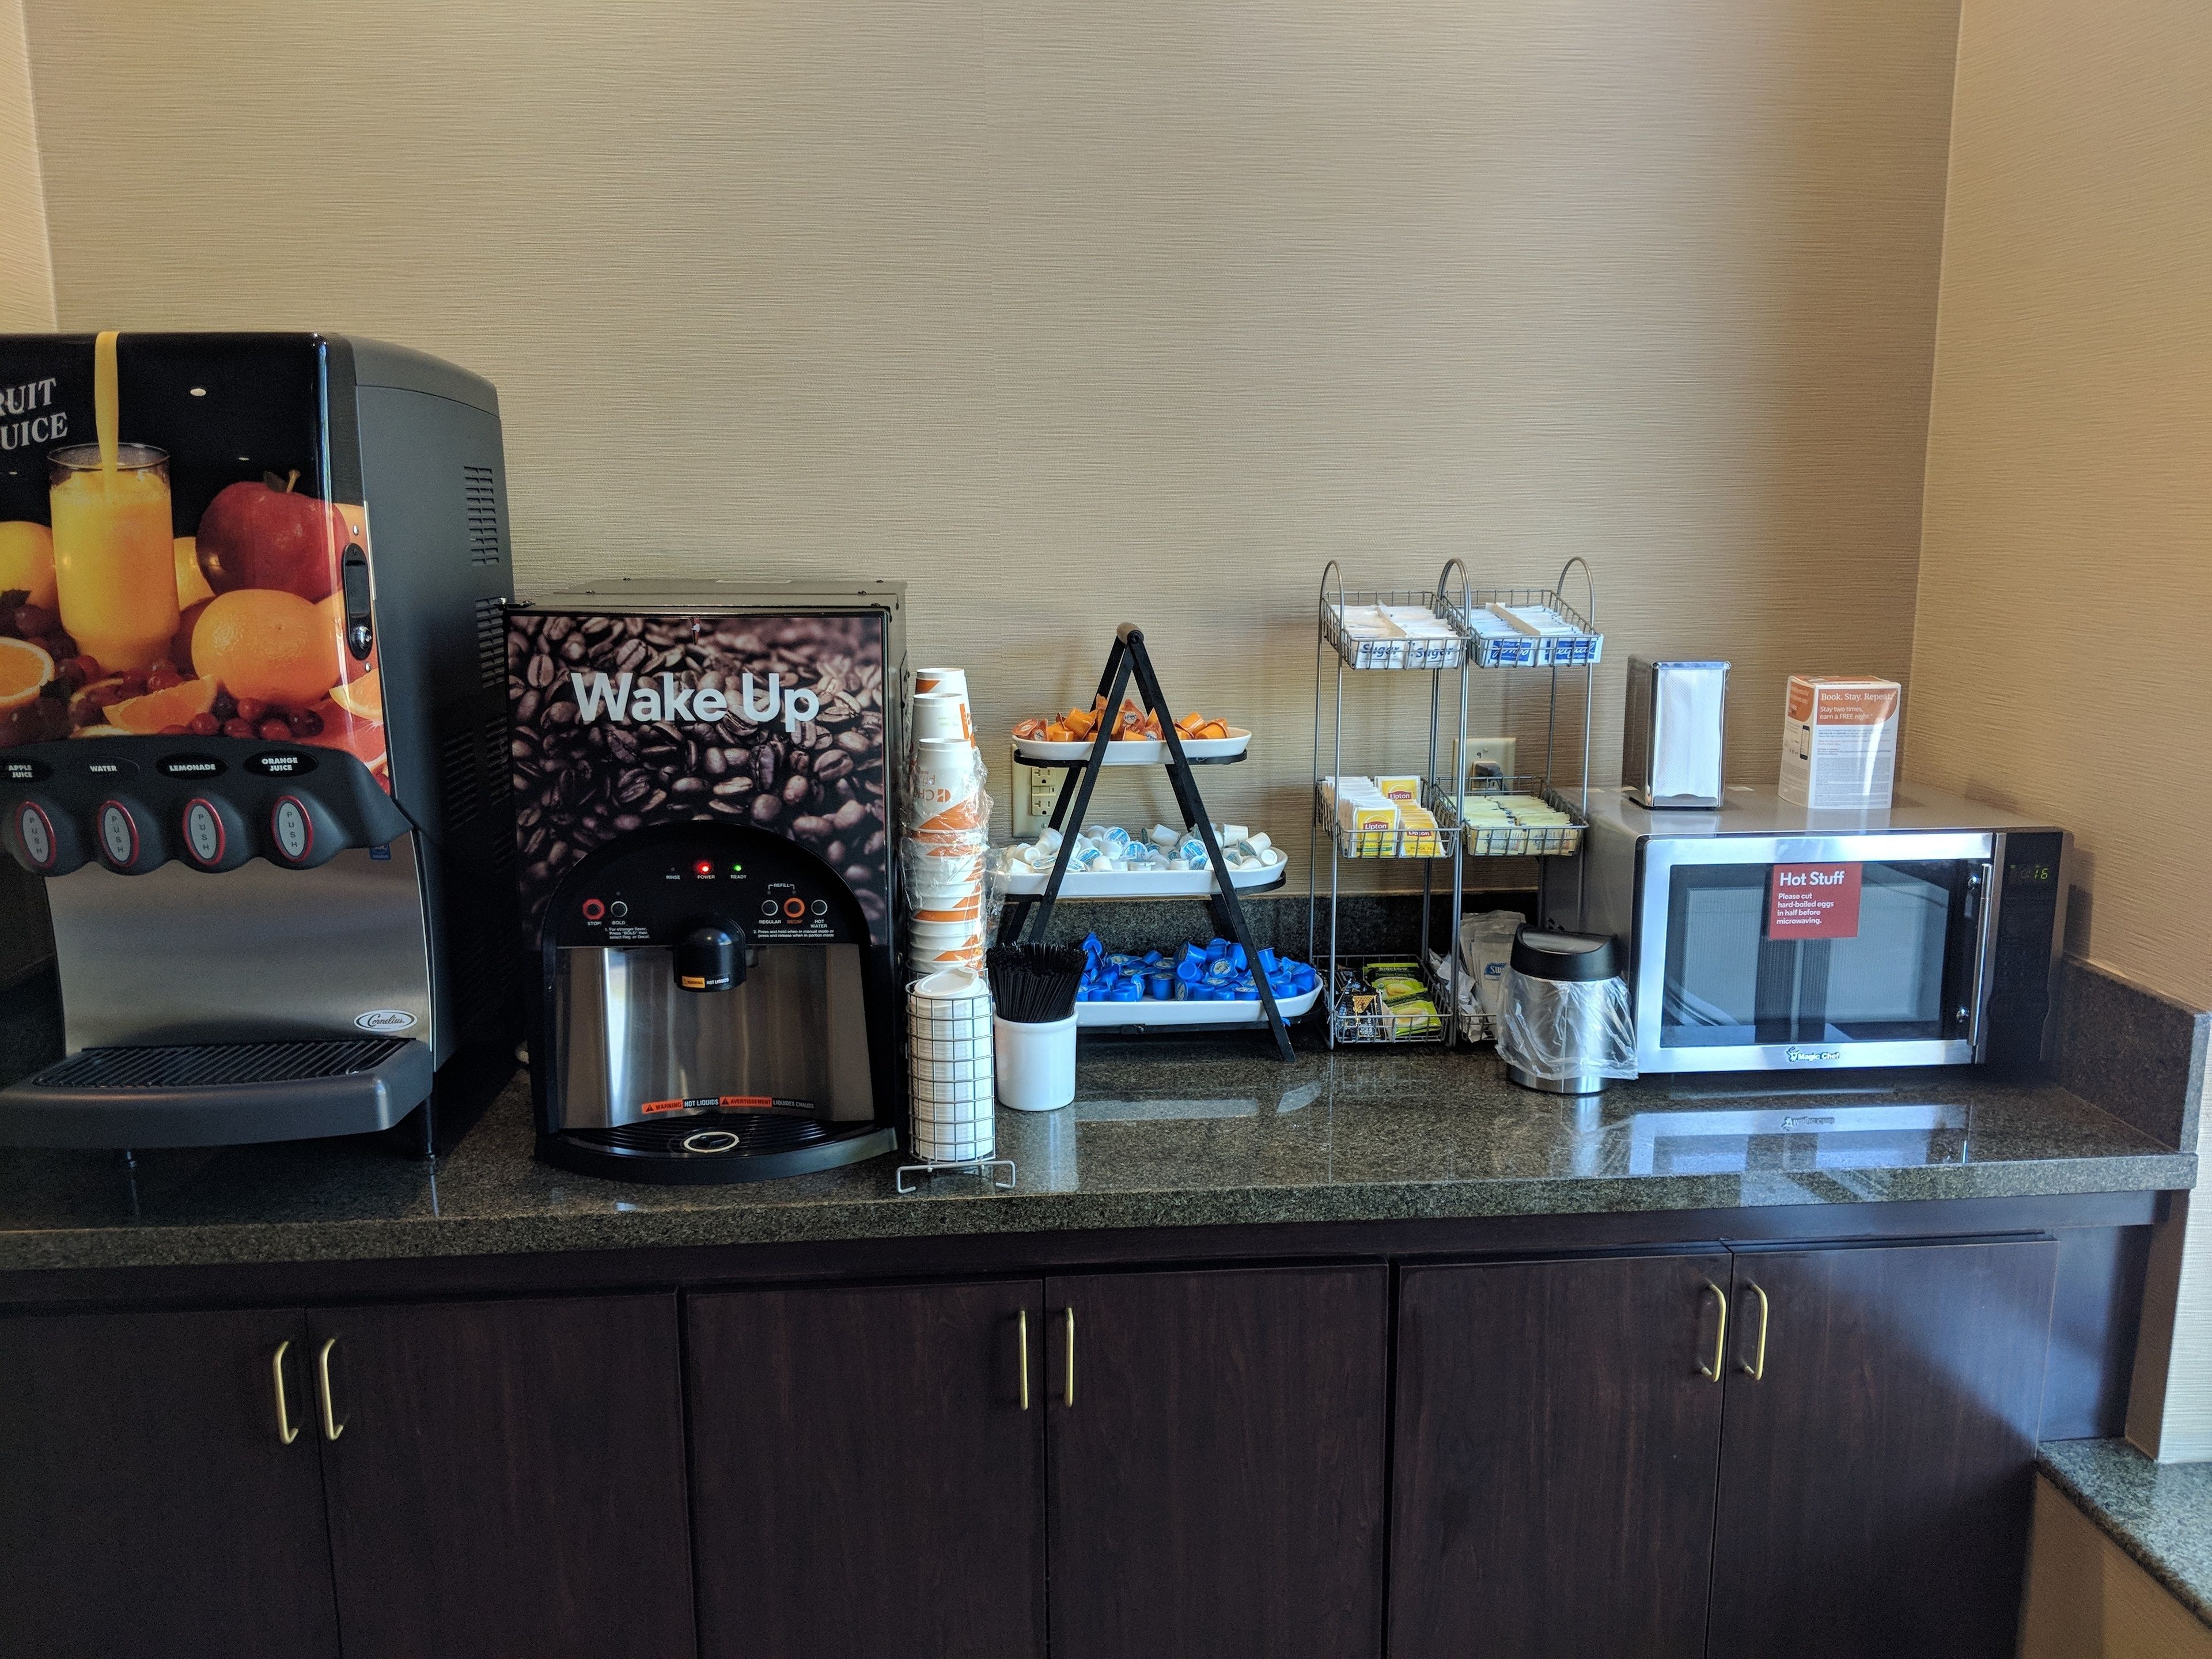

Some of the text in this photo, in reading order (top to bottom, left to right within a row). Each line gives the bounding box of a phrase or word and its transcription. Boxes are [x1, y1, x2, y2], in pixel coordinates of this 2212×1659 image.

[0, 378, 56, 416] UIT
[571, 673, 819, 732] Wake Up
[1844, 693, 1862, 702] Stay.
[29, 817, 43, 854] PUSH
[111, 816, 124, 853] PUSH
[198, 814, 210, 850] PUSH
[287, 812, 298, 847] PUSH
[1779, 870, 1845, 886] Hot Stuff
[1798, 1053, 1820, 1061] Magic
[656, 1101, 681, 1110] WARNING
